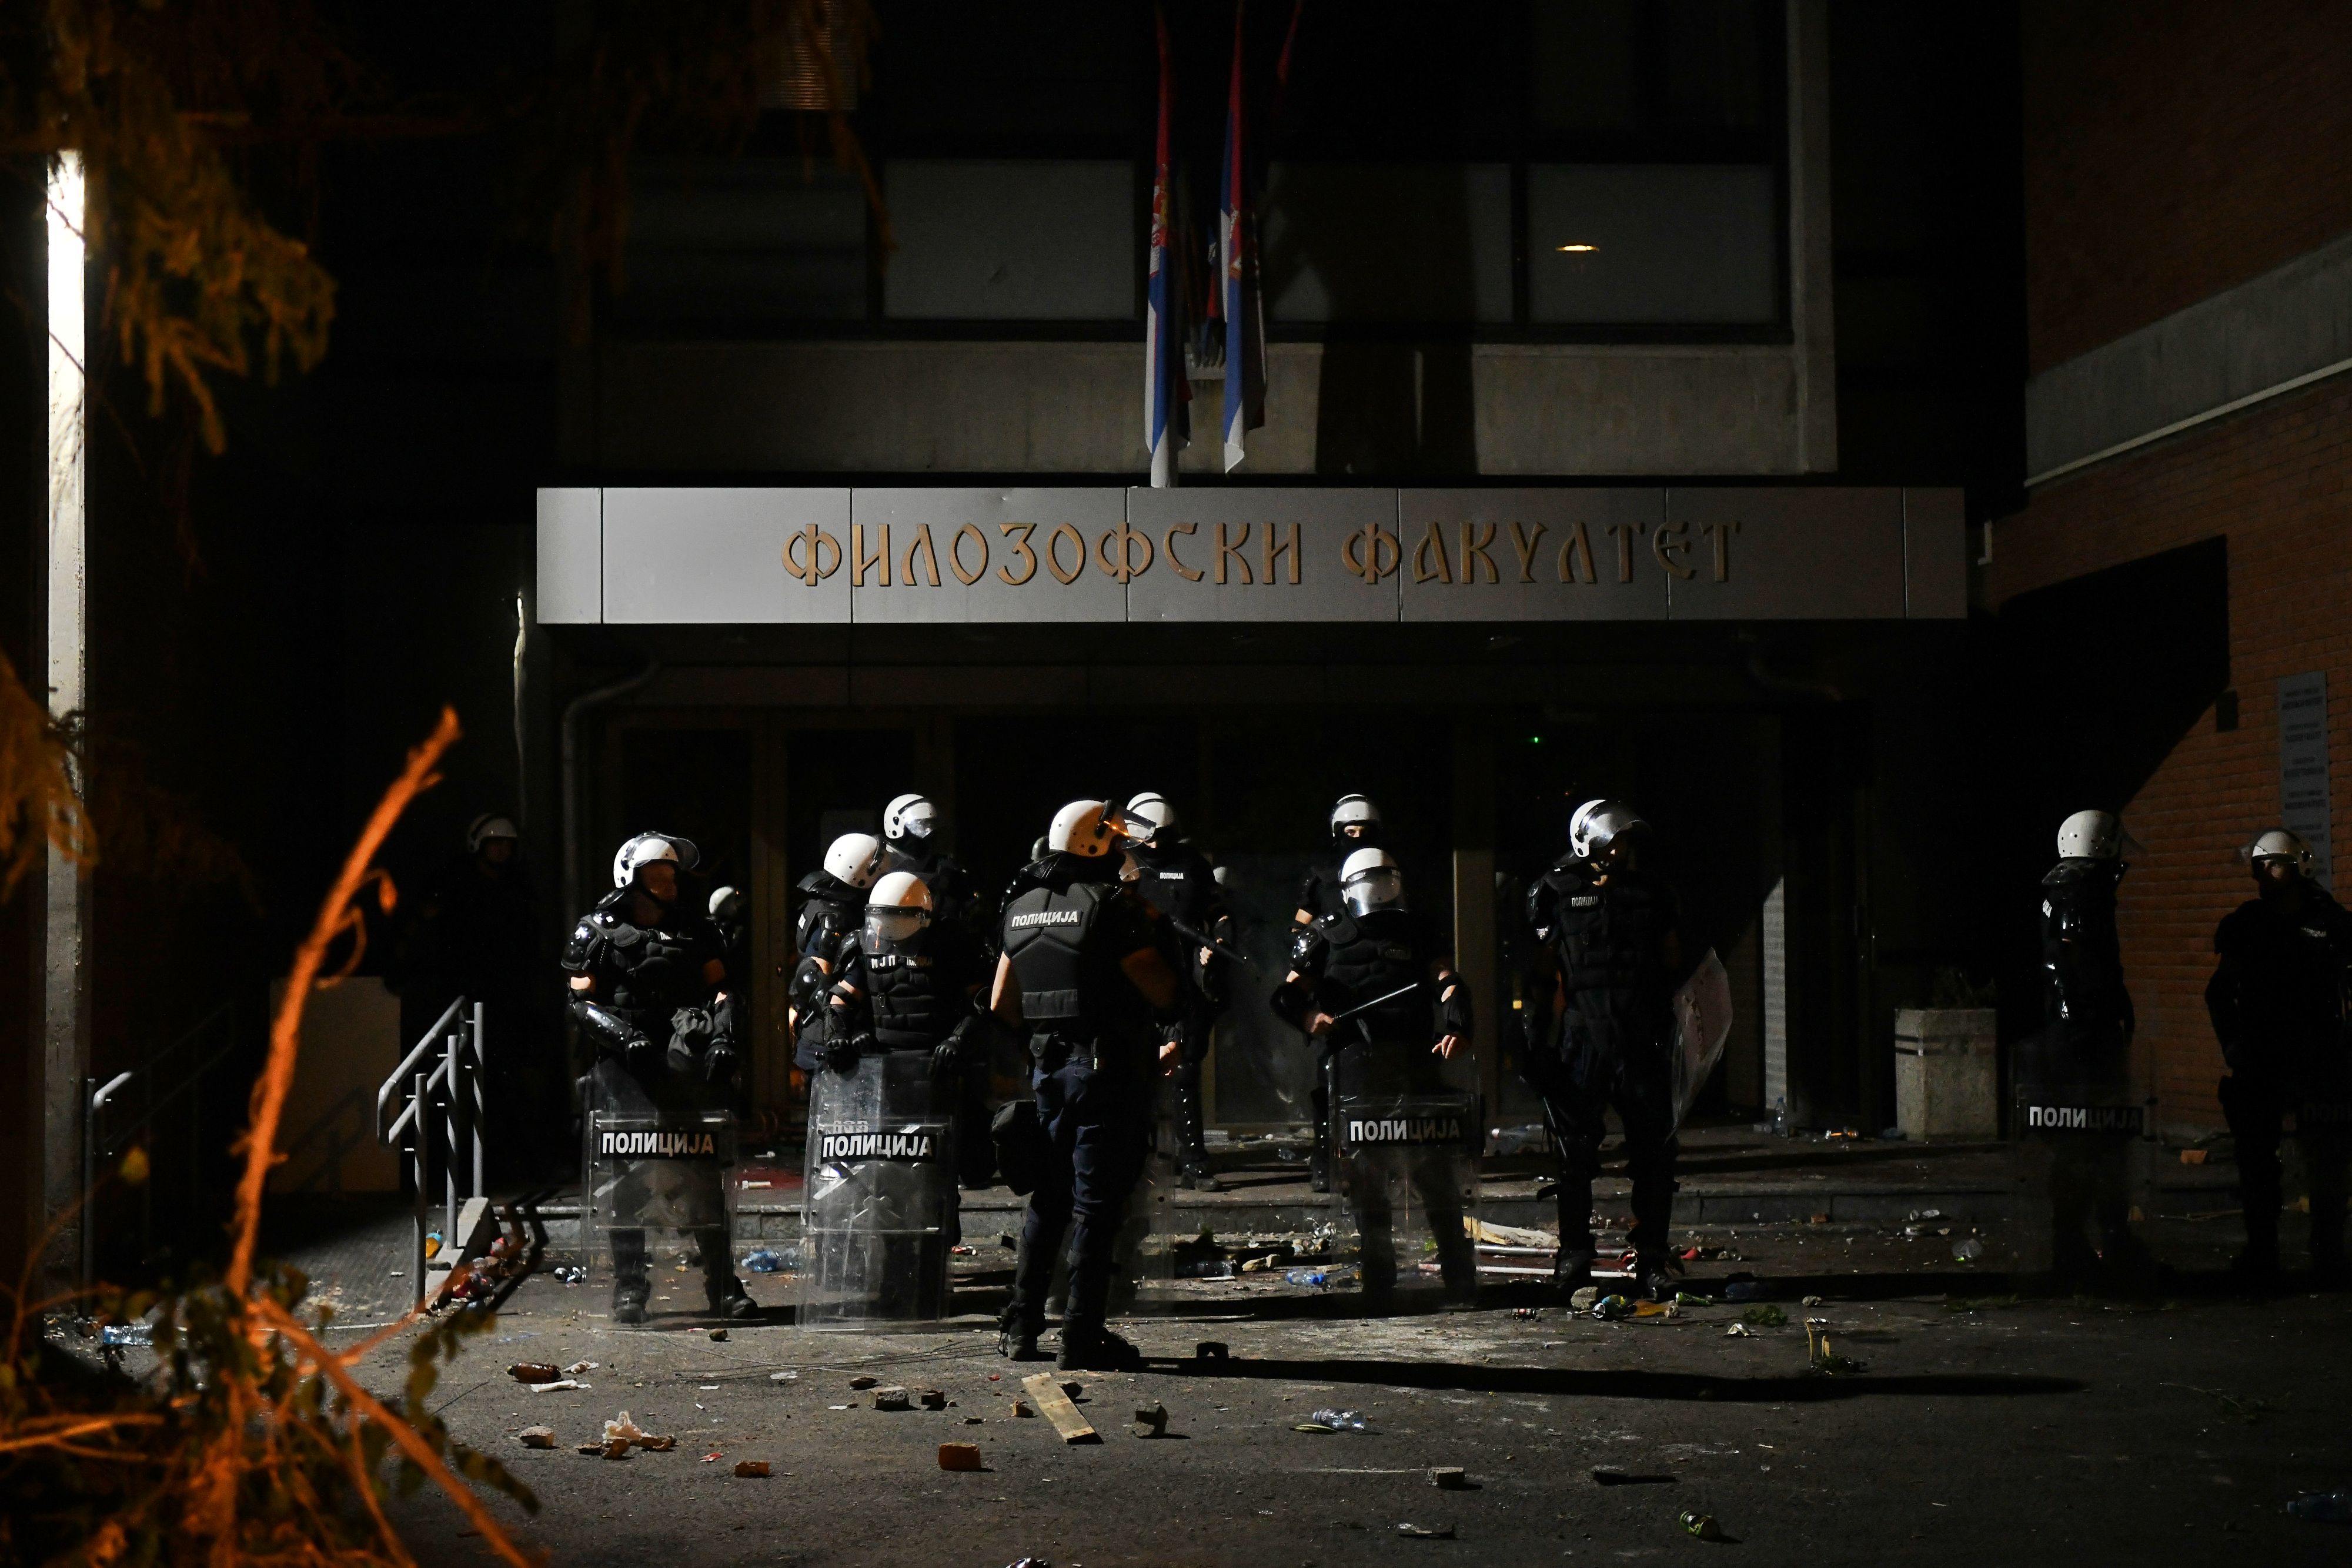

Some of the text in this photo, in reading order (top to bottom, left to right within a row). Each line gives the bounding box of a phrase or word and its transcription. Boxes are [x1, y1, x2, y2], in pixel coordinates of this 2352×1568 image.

[781, 521, 1740, 587] ФИЛОЗОФСКИ ФАКУЛТЕТ
[1011, 911, 1078, 927] ПОЛИЦИЈА
[1350, 1119, 1461, 1144] ПОЛИЦИЈА
[2029, 1106, 2144, 1132] ПОЛИЦИЈА
[602, 1132, 714, 1157] ПОЛИЦИЈА
[823, 1134, 933, 1159] ПОЛИЦИЈА
